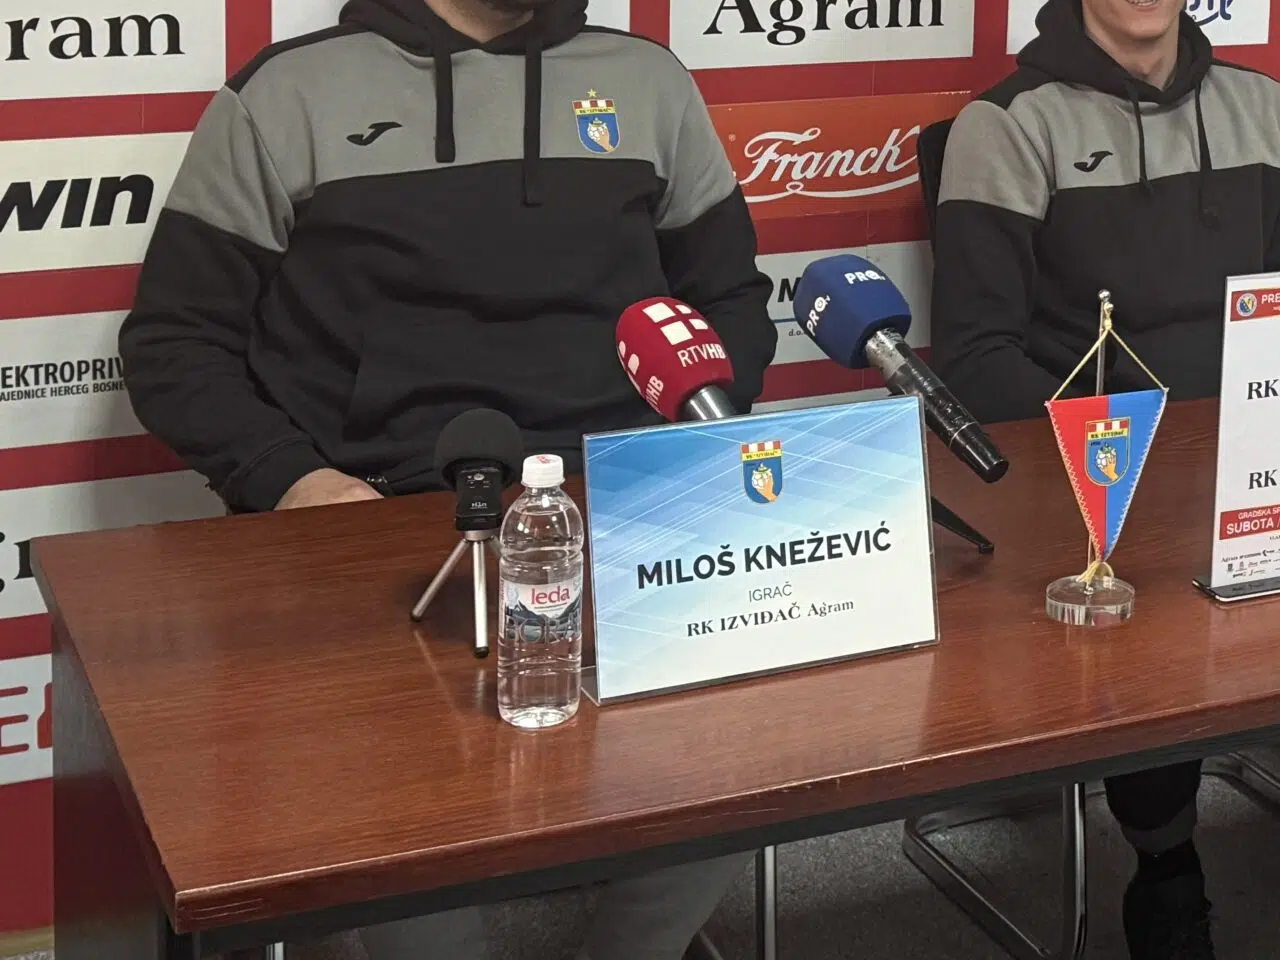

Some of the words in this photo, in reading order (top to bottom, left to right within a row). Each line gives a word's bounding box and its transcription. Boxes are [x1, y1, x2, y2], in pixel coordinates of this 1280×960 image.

[738, 125, 921, 185] Franck
[677, 342, 726, 367] RTVHB
[50, 386, 89, 397] HERCEG
[1247, 379, 1279, 400] RK
[1248, 469, 1279, 489] RK
[1238, 508, 1271, 519] GRADSKA
[1226, 519, 1274, 535] SUBOTA
[637, 544, 736, 589] MILOŠ
[744, 521, 892, 573] KNEŽEVIĆ
[531, 587, 570, 606] leda
[749, 581, 792, 602] IGRAČ
[687, 619, 714, 637] RK
[720, 602, 801, 631] IZVIĐAČ
[807, 600, 854, 618] Agram
